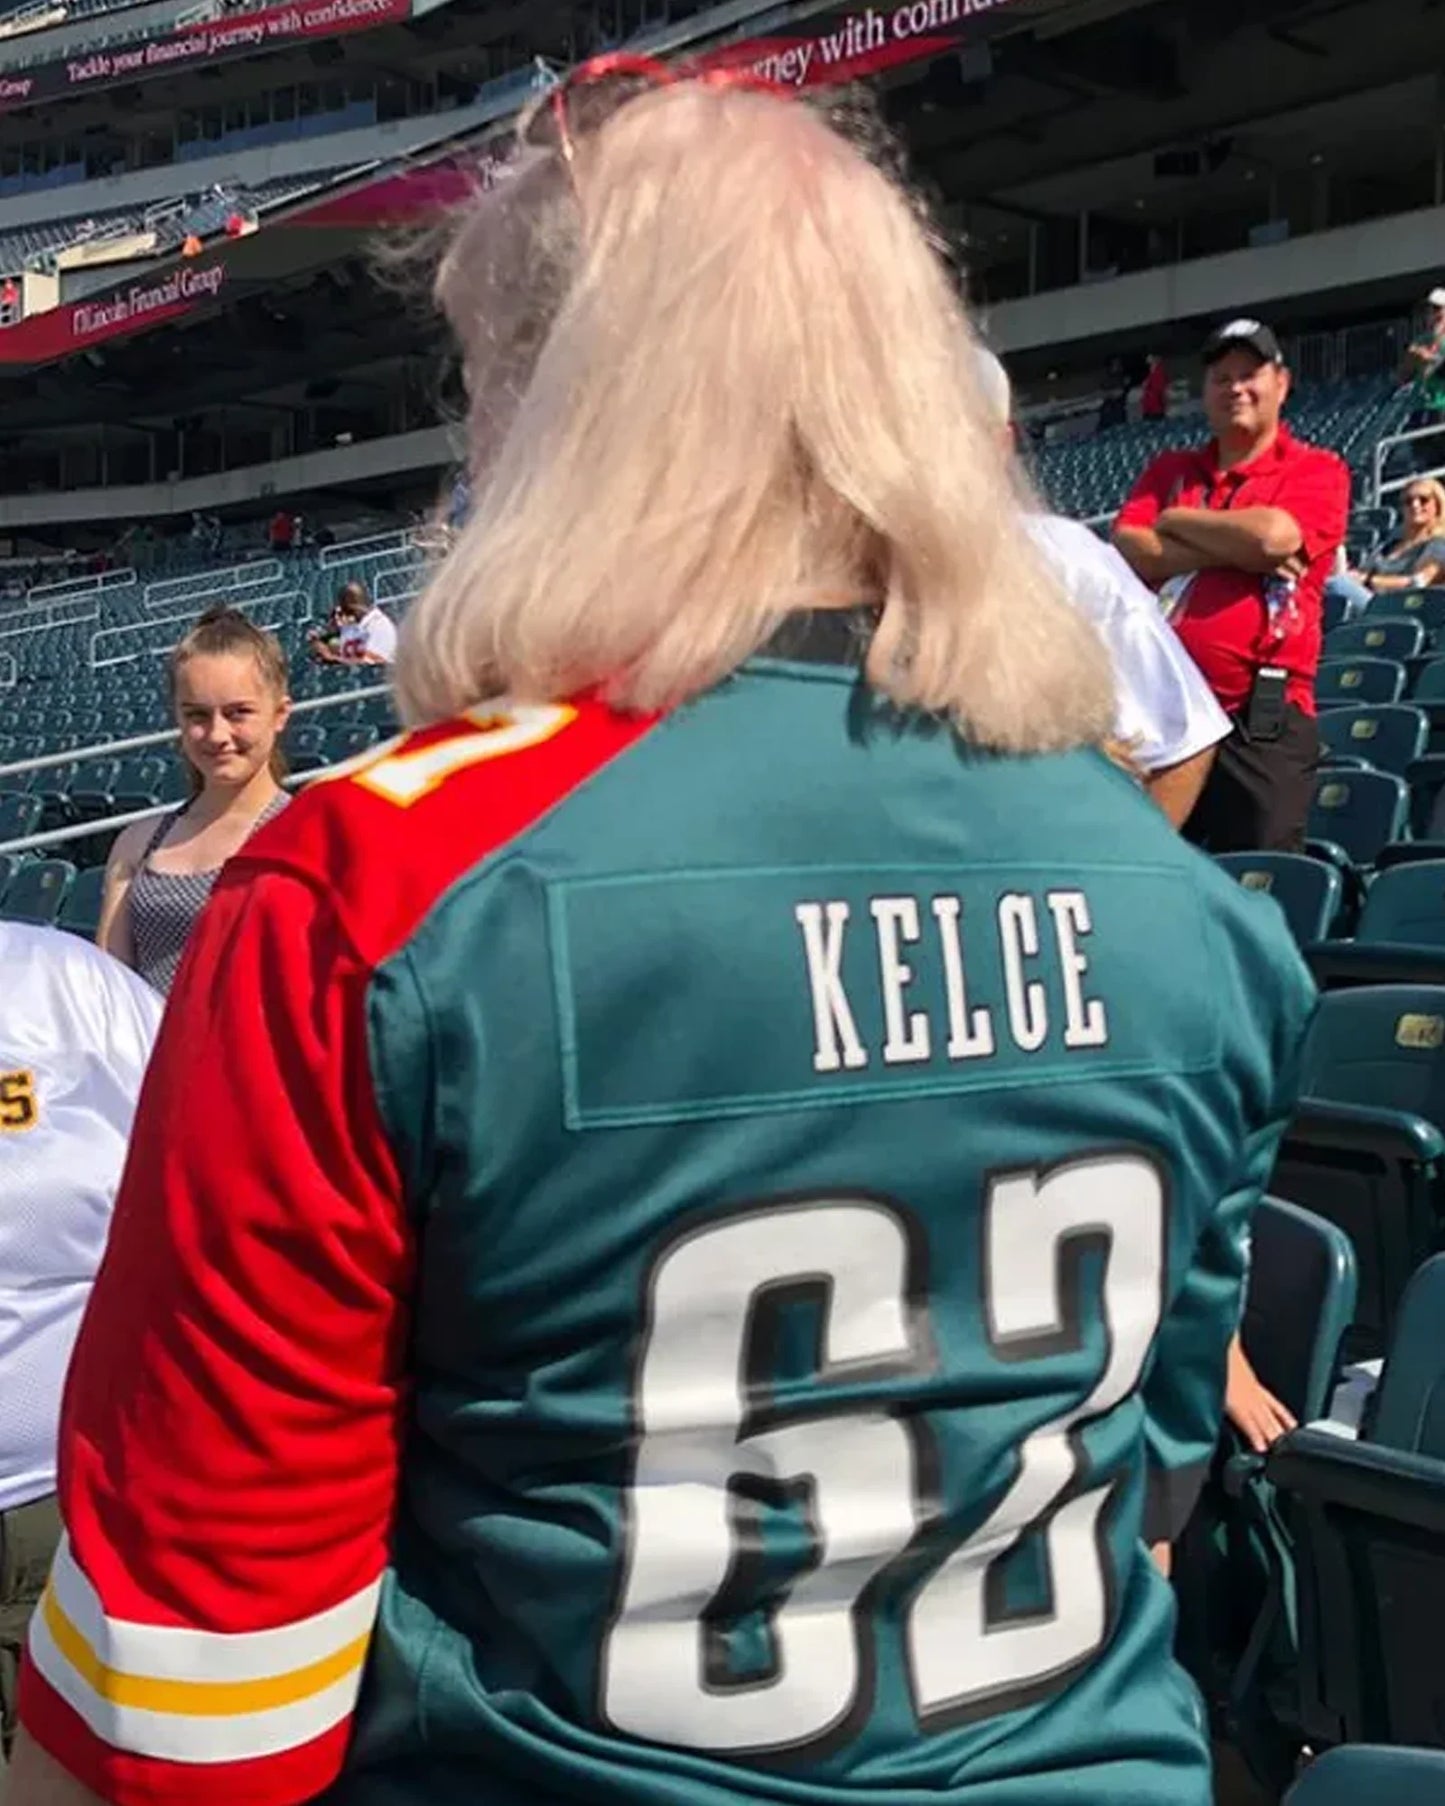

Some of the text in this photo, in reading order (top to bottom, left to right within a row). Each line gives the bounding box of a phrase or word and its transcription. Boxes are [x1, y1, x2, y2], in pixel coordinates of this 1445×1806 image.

[66, 54, 113, 82] Tackle
[112, 50, 144, 76] your
[146, 32, 207, 64] financial
[208, 23, 266, 55] journey
[266, 10, 301, 34] with
[750, 43, 814, 87] rney
[819, 10, 884, 64] with
[128, 271, 180, 316] Financial
[181, 264, 225, 298] Group
[793, 889, 1108, 1072] KELCE
[0, 1068, 39, 1133] S
[598, 1145, 1178, 1760] 62
